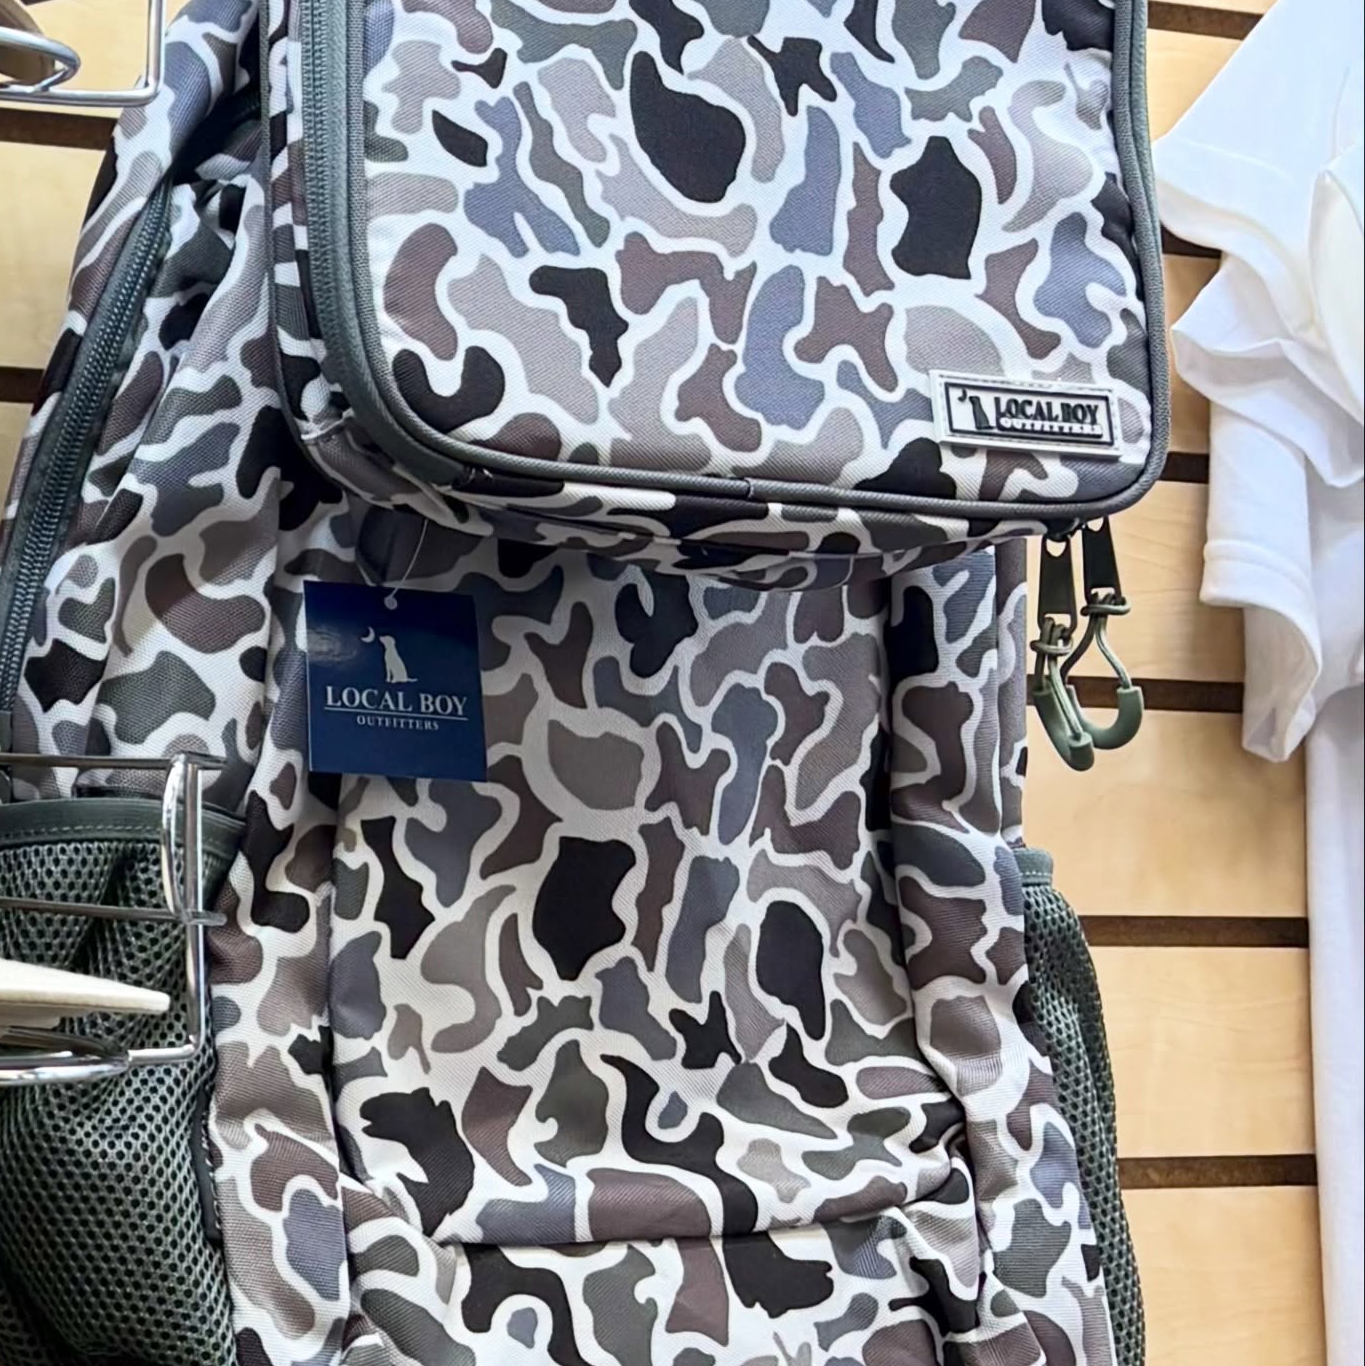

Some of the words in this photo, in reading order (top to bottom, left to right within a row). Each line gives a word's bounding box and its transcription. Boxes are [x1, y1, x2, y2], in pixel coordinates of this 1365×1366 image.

[994, 397, 1059, 421] LOCAL
[1060, 402, 1099, 425] BOY
[326, 686, 412, 712] LOCAL
[420, 693, 467, 716] BOY
[357, 715, 439, 730] OUTFITTERS
